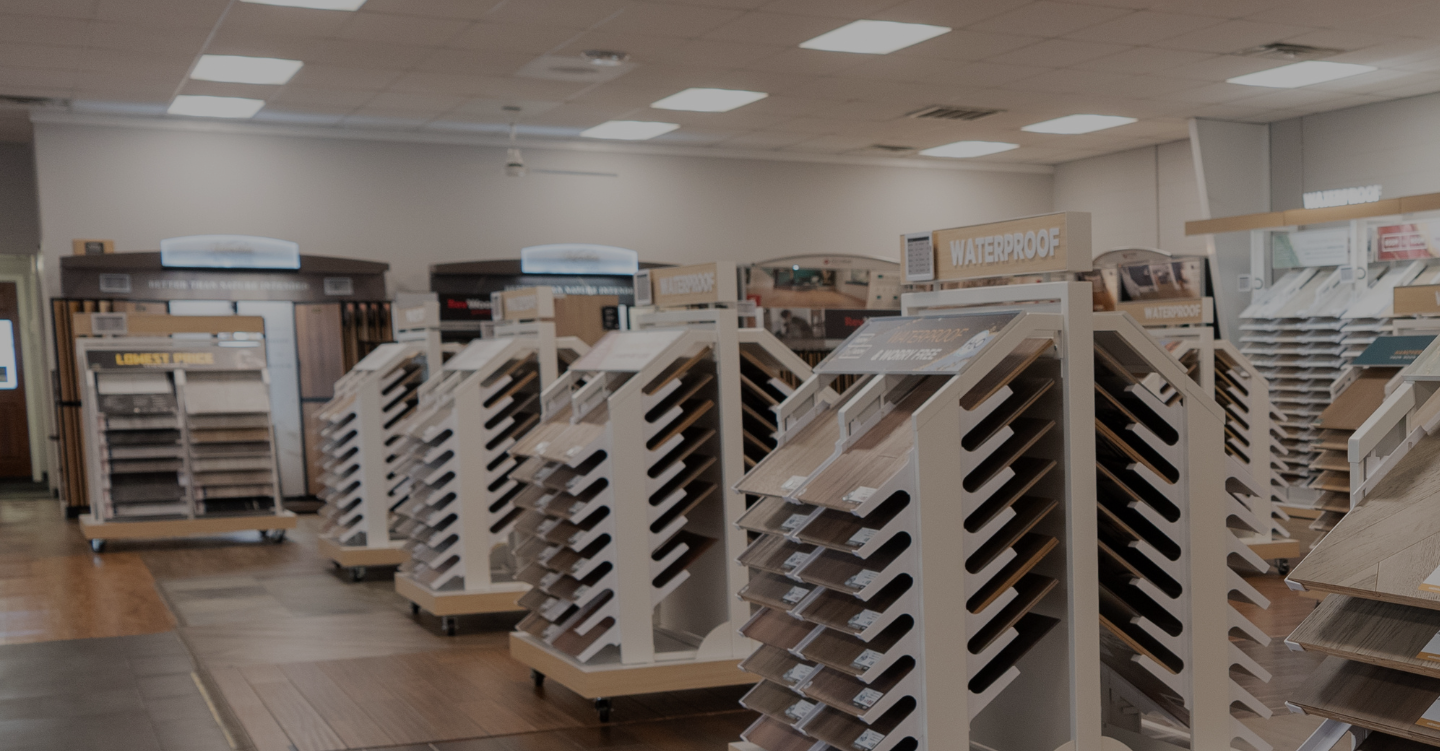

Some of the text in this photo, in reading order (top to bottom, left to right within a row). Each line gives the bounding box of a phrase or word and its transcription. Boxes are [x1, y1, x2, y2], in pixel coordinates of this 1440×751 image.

[950, 228, 1060, 266] WATERPROOF
[1143, 304, 1201, 319] WATERPROOF
[886, 328, 970, 344] WATERPROOF
[115, 353, 170, 366] LOWEST
[173, 352, 215, 365] PRICE
[879, 348, 920, 361] WORRY
[910, 348, 943, 360] FREE
